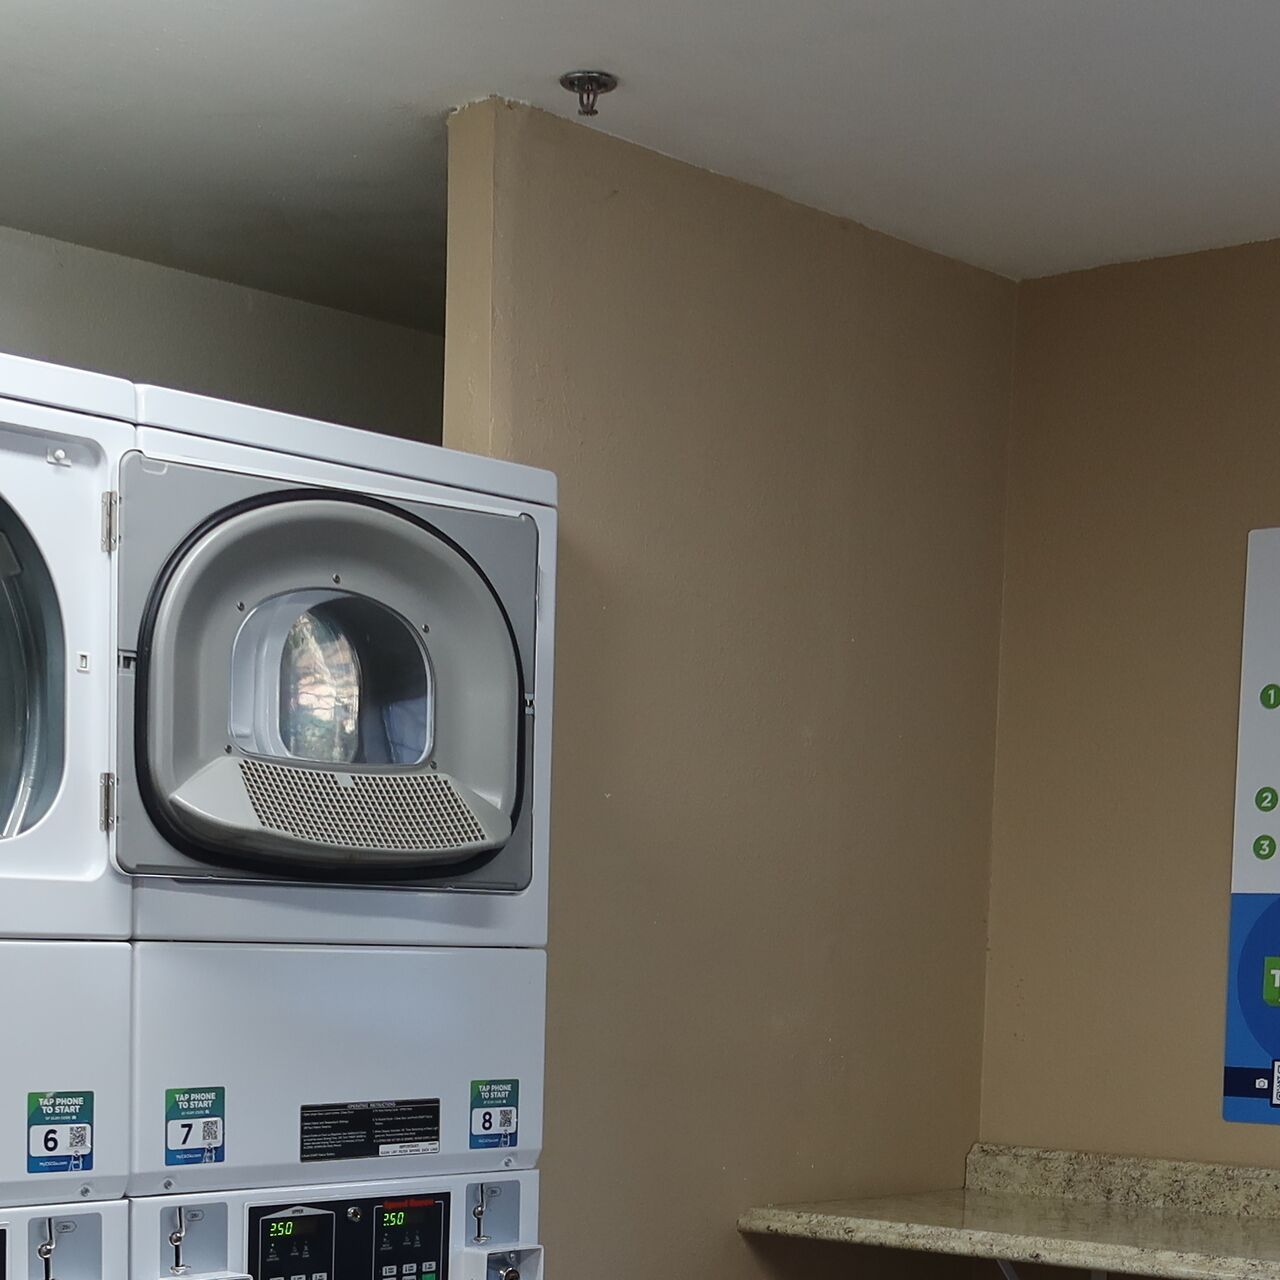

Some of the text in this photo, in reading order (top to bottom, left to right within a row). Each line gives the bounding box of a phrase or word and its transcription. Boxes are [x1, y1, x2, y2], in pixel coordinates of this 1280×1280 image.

[1267, 689, 1275, 704] 1
[1261, 792, 1272, 807] 2
[1259, 840, 1269, 855] 3
[56, 1097, 84, 1105] PHONE
[482, 1111, 492, 1131] 8
[44, 1129, 58, 1152] 6
[181, 1123, 193, 1145] 7
